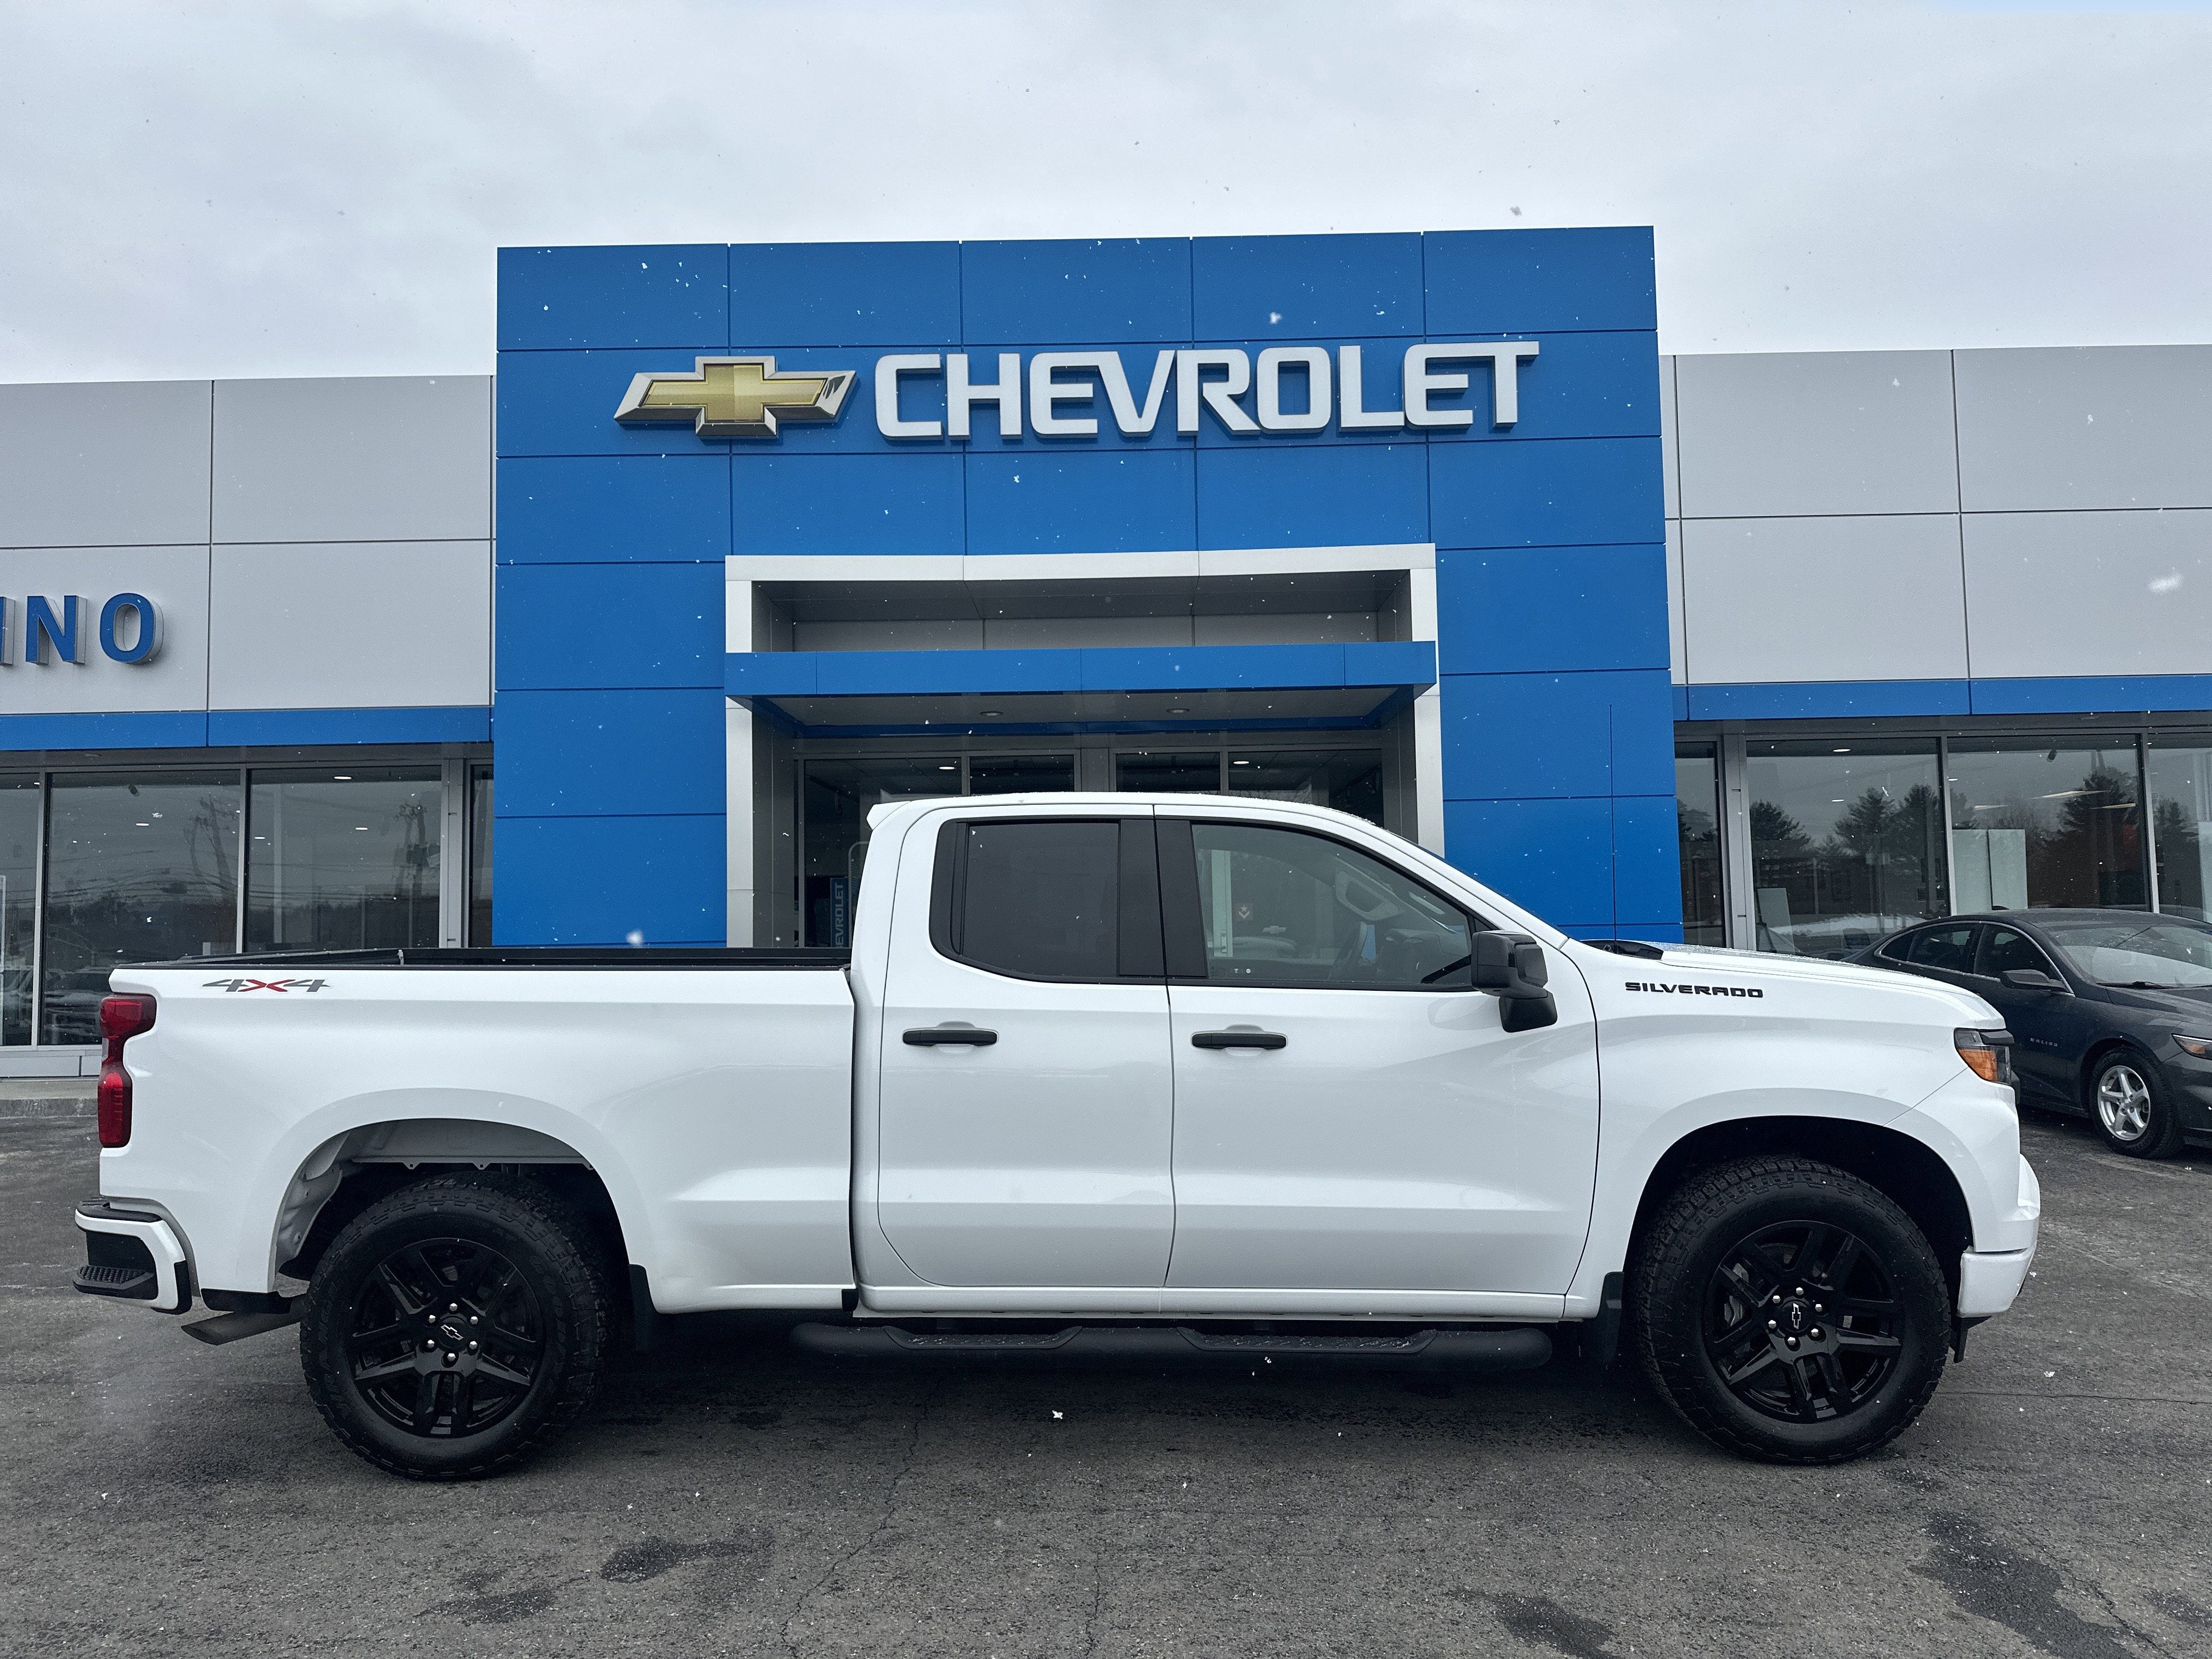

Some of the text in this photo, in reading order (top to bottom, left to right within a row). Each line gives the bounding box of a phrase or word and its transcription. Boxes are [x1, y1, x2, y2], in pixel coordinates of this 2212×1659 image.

[875, 341, 1539, 439] CHEVROLET
[834, 882, 844, 947] EVROLET
[1625, 981, 1763, 998] SILVERADO
